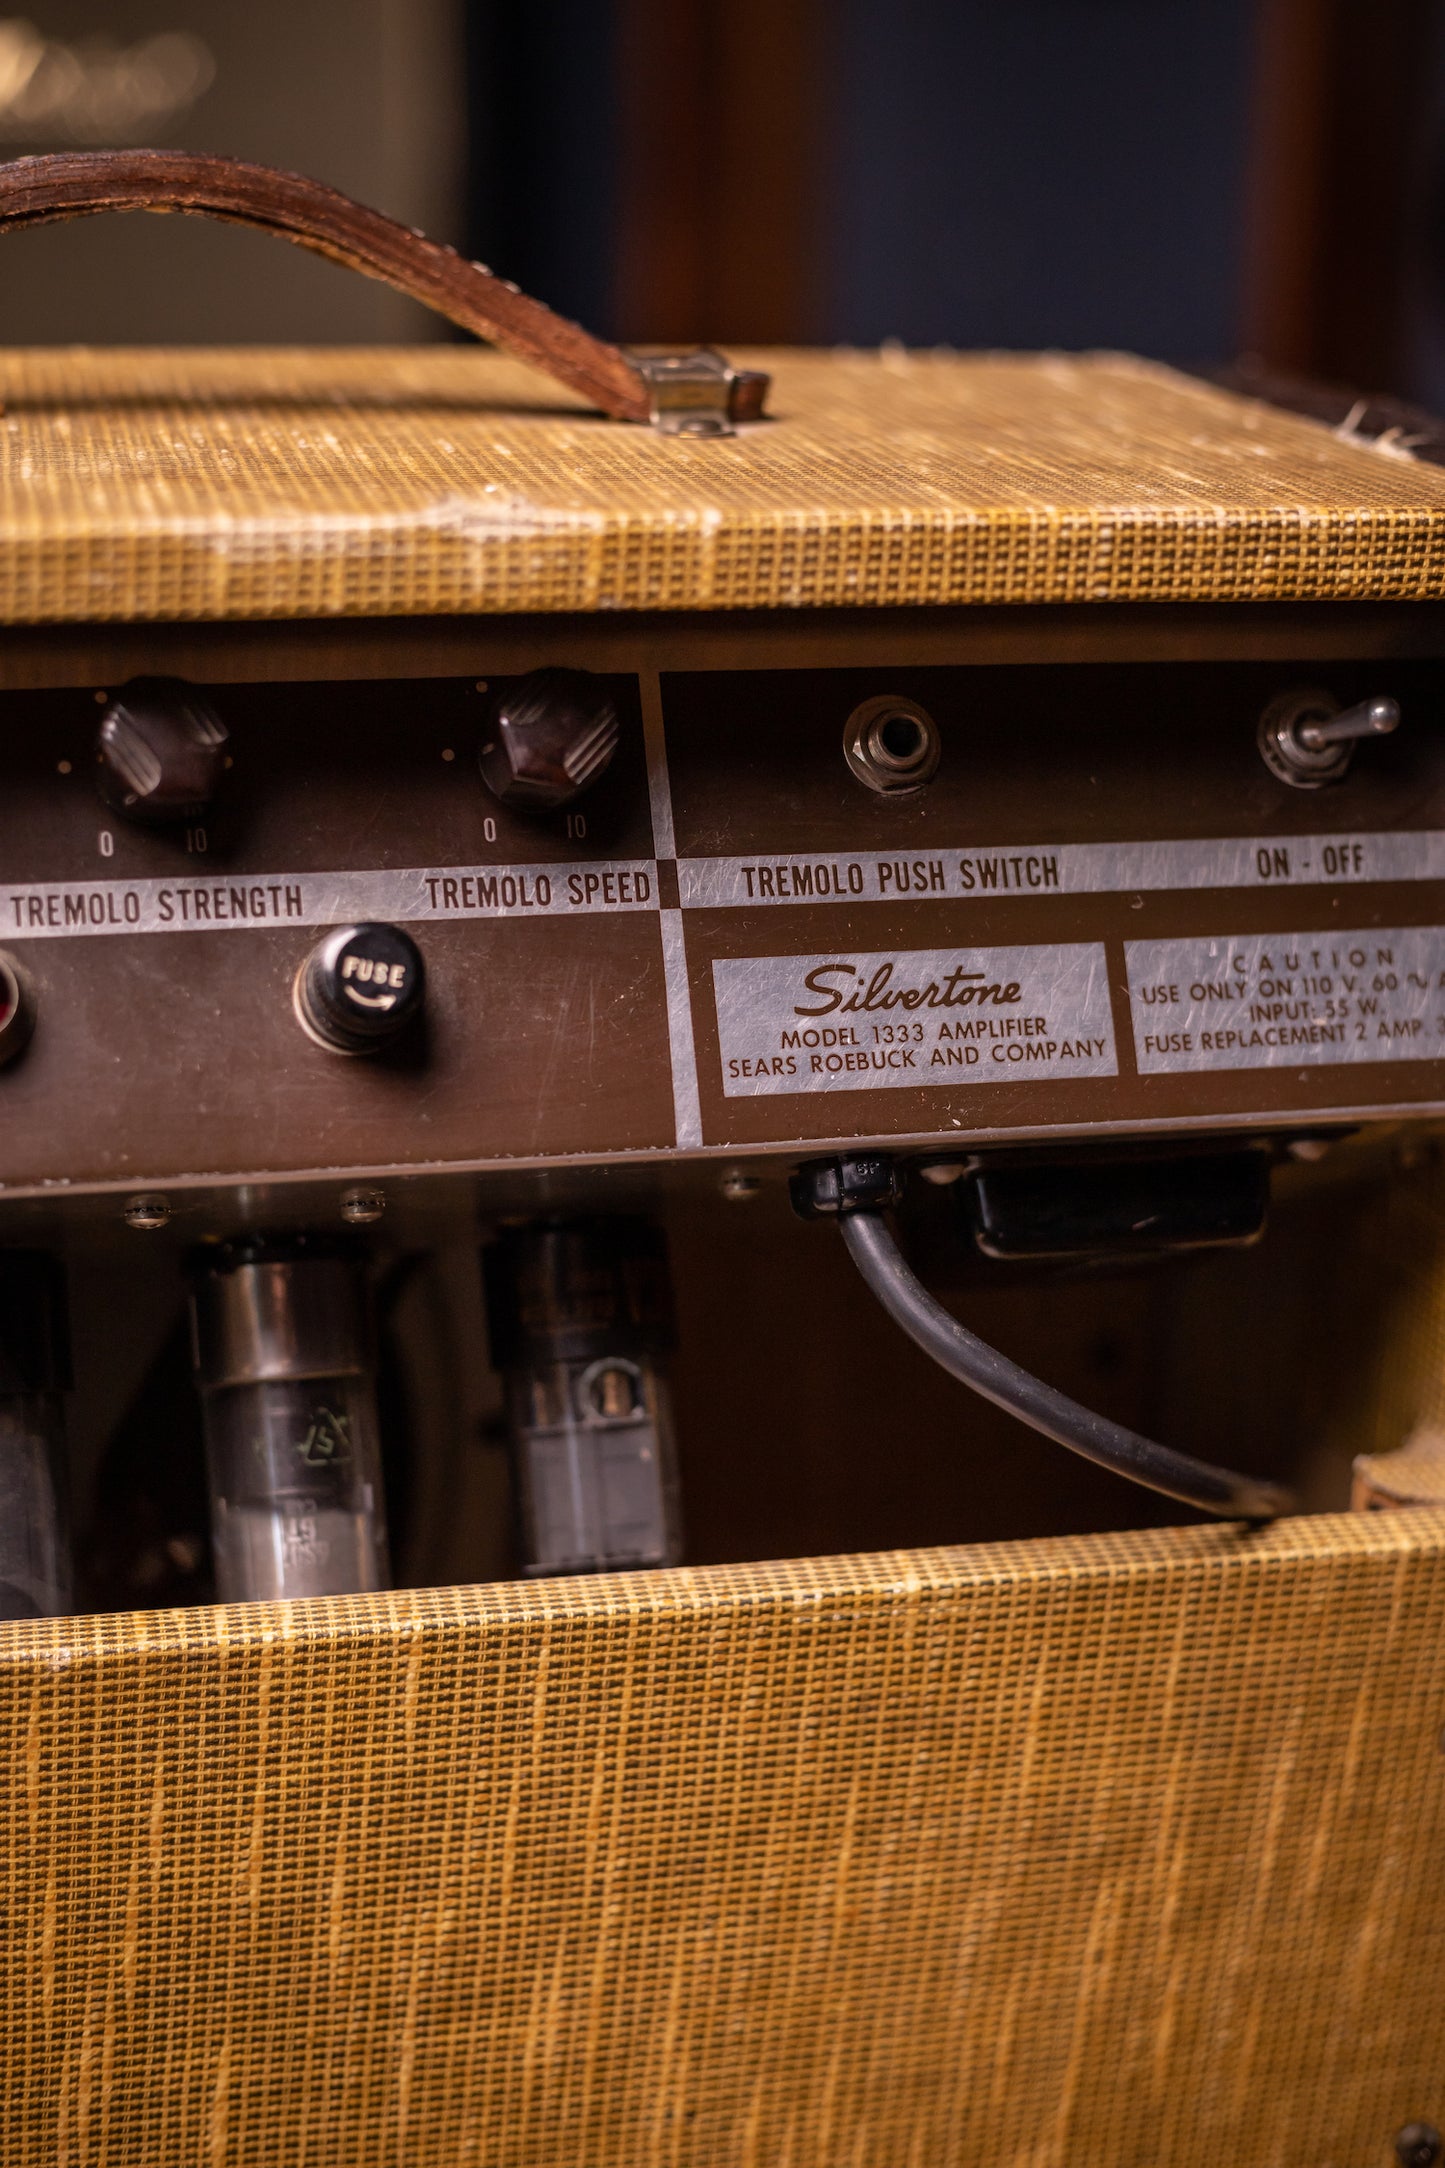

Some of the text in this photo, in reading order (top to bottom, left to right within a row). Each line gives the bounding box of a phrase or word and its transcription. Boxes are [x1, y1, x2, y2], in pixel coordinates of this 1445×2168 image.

[186, 827, 208, 853] 10
[484, 817, 497, 842] 0
[566, 814, 587, 839] 10
[100, 830, 114, 857] 0
[742, 856, 1059, 898] TREMOLO PUSH SWITCH
[1256, 848, 1290, 879] ON
[1323, 845, 1363, 875] OFF
[10, 885, 303, 928] TREMOLO STRENGTH
[425, 871, 651, 909] TREMOLO SPEED
[342, 955, 406, 988] FUSE
[1142, 985, 1180, 1004] USE
[1190, 981, 1246, 1001] ONLY
[1258, 979, 1292, 998] ON
[1302, 976, 1333, 995] 110
[1372, 972, 1398, 992] 60
[794, 963, 1022, 1017] Silvertone
[1326, 1000, 1349, 1019] 55
[781, 1017, 1048, 1050] MODEL 1333 AMPLIFIER
[1144, 1033, 1193, 1053] FUSE
[1201, 1024, 1346, 1050] REPLACEMENT
[1355, 1021, 1367, 1041] 2
[729, 1039, 1106, 1079] SEARS ROEBUCK AND COMPANY
